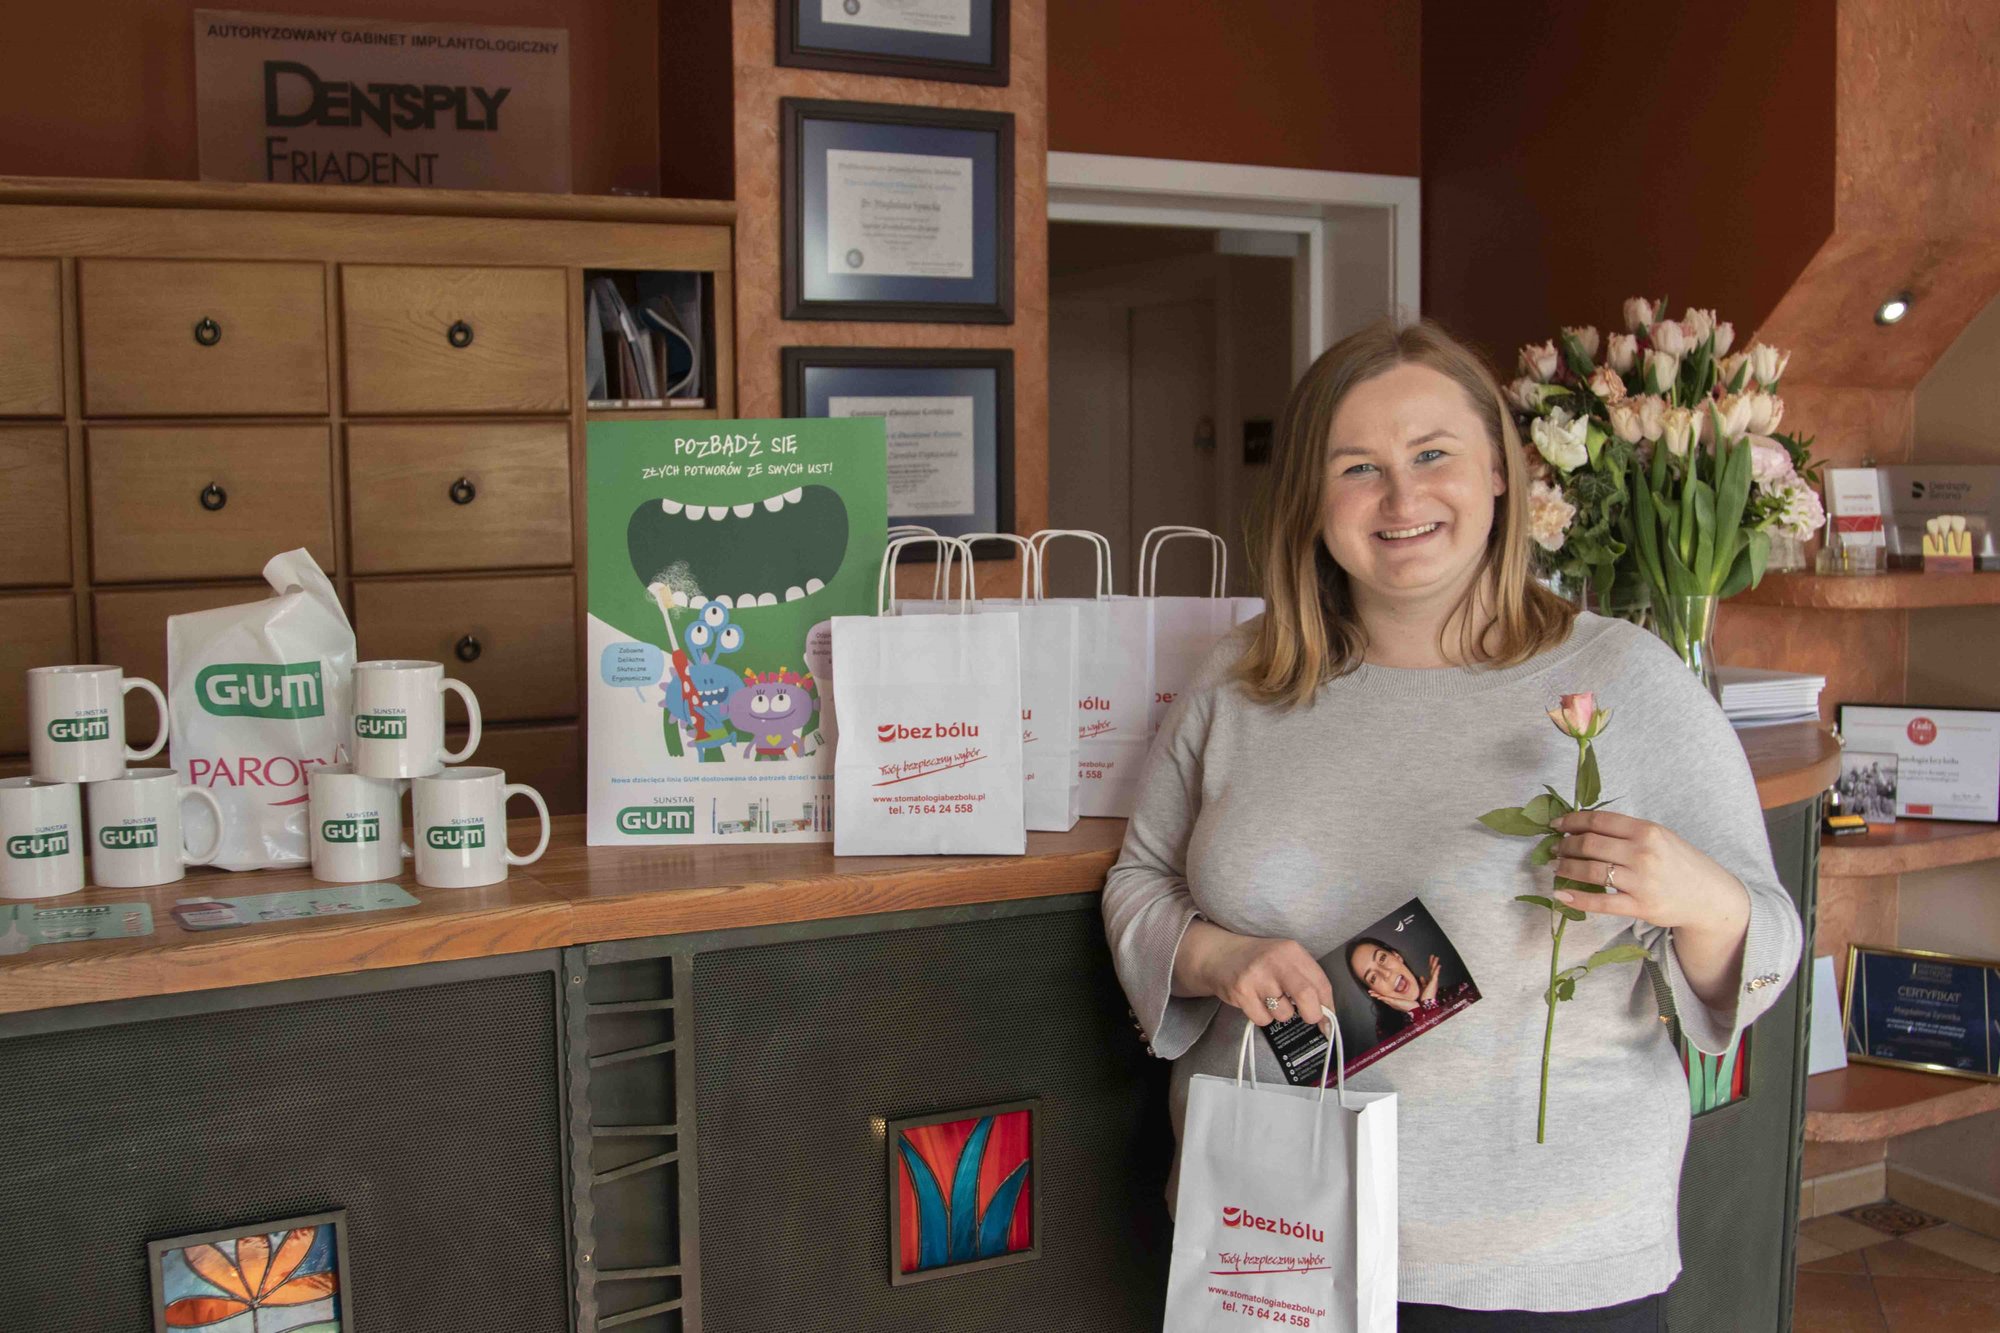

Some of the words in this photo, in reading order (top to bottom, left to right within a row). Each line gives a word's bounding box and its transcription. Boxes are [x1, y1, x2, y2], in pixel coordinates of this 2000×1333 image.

[207, 25, 337, 43] AUTORYZOWANY
[341, 32, 406, 46] GABINET
[411, 35, 559, 55] IMPLANTOLOGICZNY
[674, 433, 764, 458] POZBĄDŹ
[771, 434, 797, 455] SIĘ
[642, 464, 680, 479] ZŁYCH
[684, 462, 741, 477] POTWORÓW
[747, 463, 763, 478] ZE
[768, 463, 803, 476] SWYCH
[807, 462, 833, 475] UST!
[75, 708, 108, 717] SUNSTAR
[878, 764, 901, 780] Twój
[903, 755, 953, 774] bezpieczny
[954, 747, 981, 768] wybór
[632, 776, 665, 784] dziecięca
[759, 775, 785, 783] potrzeb
[1086, 771, 1102, 779] 558
[653, 796, 695, 804] SUNSTAR
[873, 793, 986, 804] www.stomatologiabezbolu.pl
[889, 806, 905, 815] tel.
[908, 805, 921, 815] 75
[924, 805, 936, 814] 64
[939, 804, 951, 814] 24
[954, 803, 973, 814] 558
[346, 811, 379, 819] SUNSTAR
[123, 817, 156, 826] SUNSTAR
[451, 817, 484, 825] SUNSTAR
[35, 824, 68, 833] SUNSTAR
[1897, 985, 1962, 1003] CERTYFIKAT
[1218, 1252, 1241, 1271] Twój
[1243, 1252, 1296, 1270] bezpieczny
[1298, 1252, 1325, 1274] wybór
[1208, 1285, 1325, 1317] www.stomatologiabezbolu.pl
[1222, 1301, 1238, 1313] tel.
[1241, 1304, 1254, 1316] 75
[1257, 1308, 1270, 1319] 64
[1273, 1311, 1286, 1323] 24
[1290, 1314, 1310, 1328] 558
